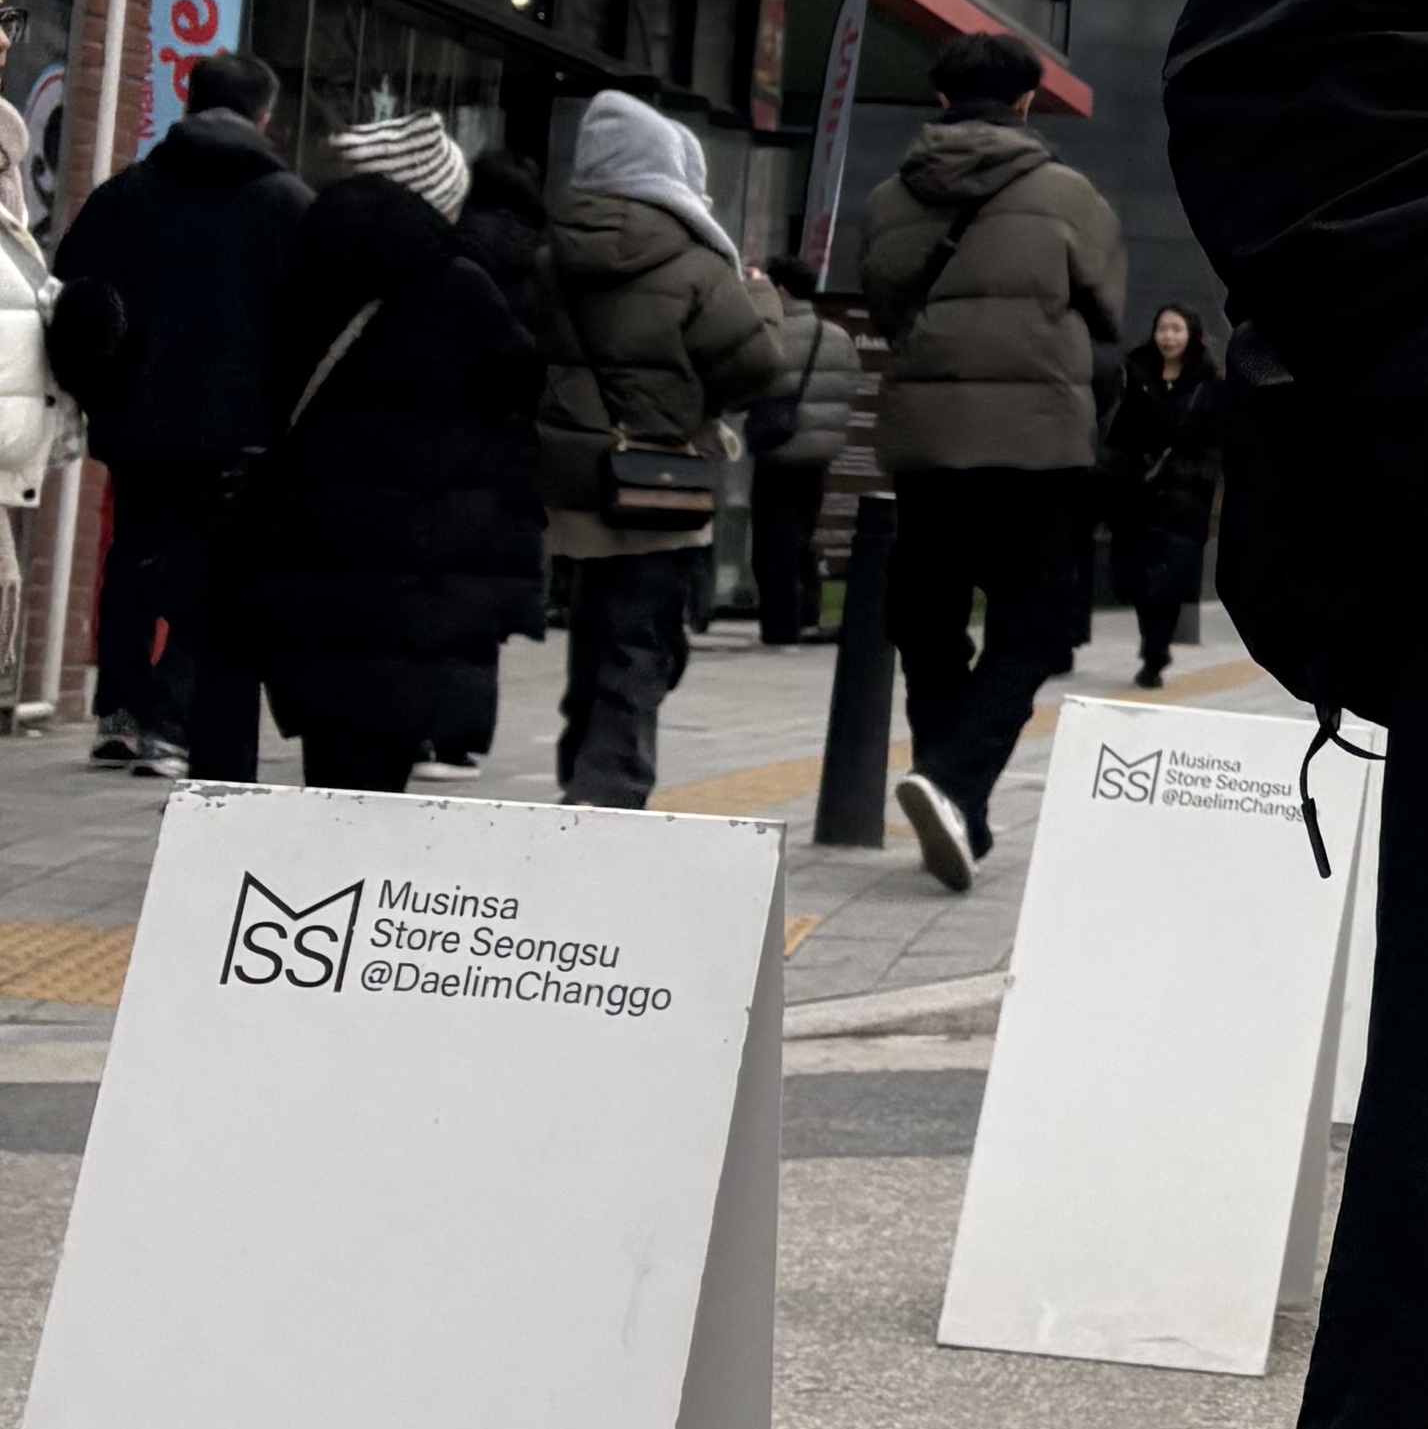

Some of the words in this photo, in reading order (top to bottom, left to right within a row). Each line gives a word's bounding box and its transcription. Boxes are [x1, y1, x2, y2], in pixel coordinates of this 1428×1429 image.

[1169, 750, 1241, 773] Musinsa
[1165, 769, 1212, 789] Store
[1216, 775, 1292, 798] Seongsu
[378, 878, 520, 920] Musinsa
[370, 918, 461, 954] Store
[469, 926, 621, 973] Seongsu
[360, 959, 673, 1017] @DaelimChanggo
